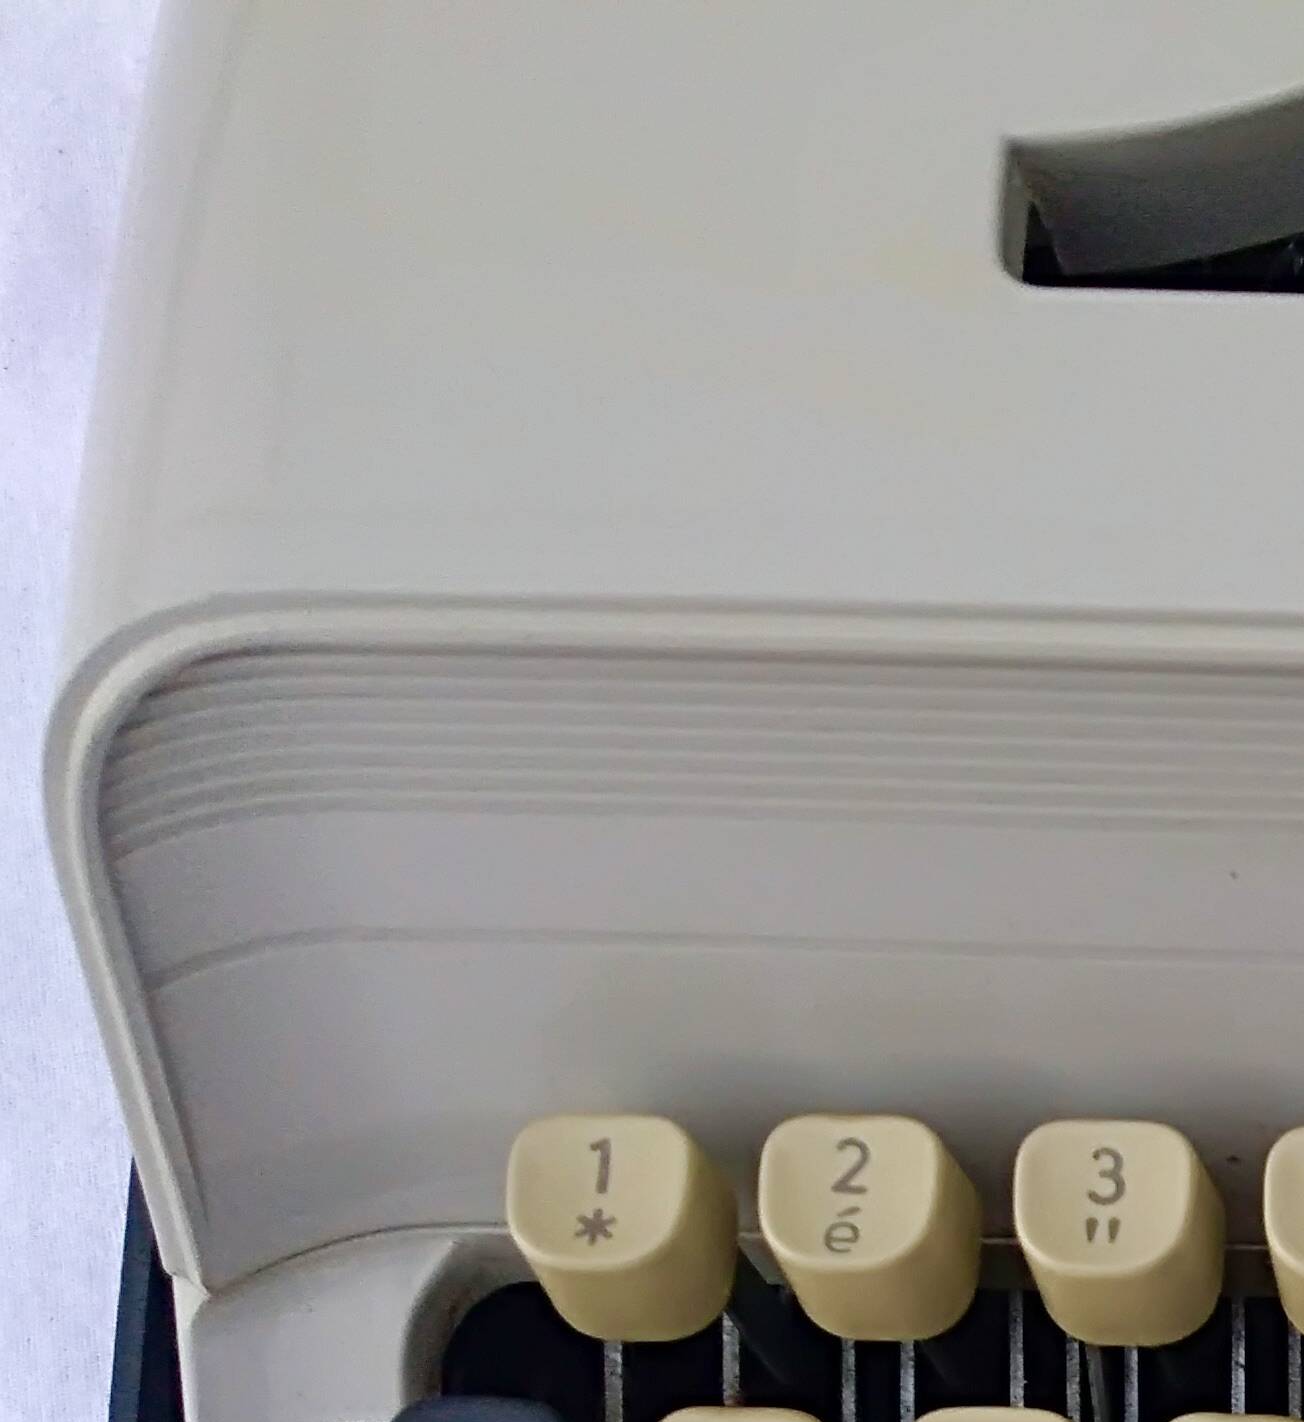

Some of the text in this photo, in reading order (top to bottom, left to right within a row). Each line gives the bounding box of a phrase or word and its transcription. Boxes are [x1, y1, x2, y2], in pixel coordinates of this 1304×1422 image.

[589, 1137, 612, 1195] 1
[830, 1136, 871, 1196] 2
[1087, 1146, 1127, 1207] 3
[823, 1205, 862, 1254] é
